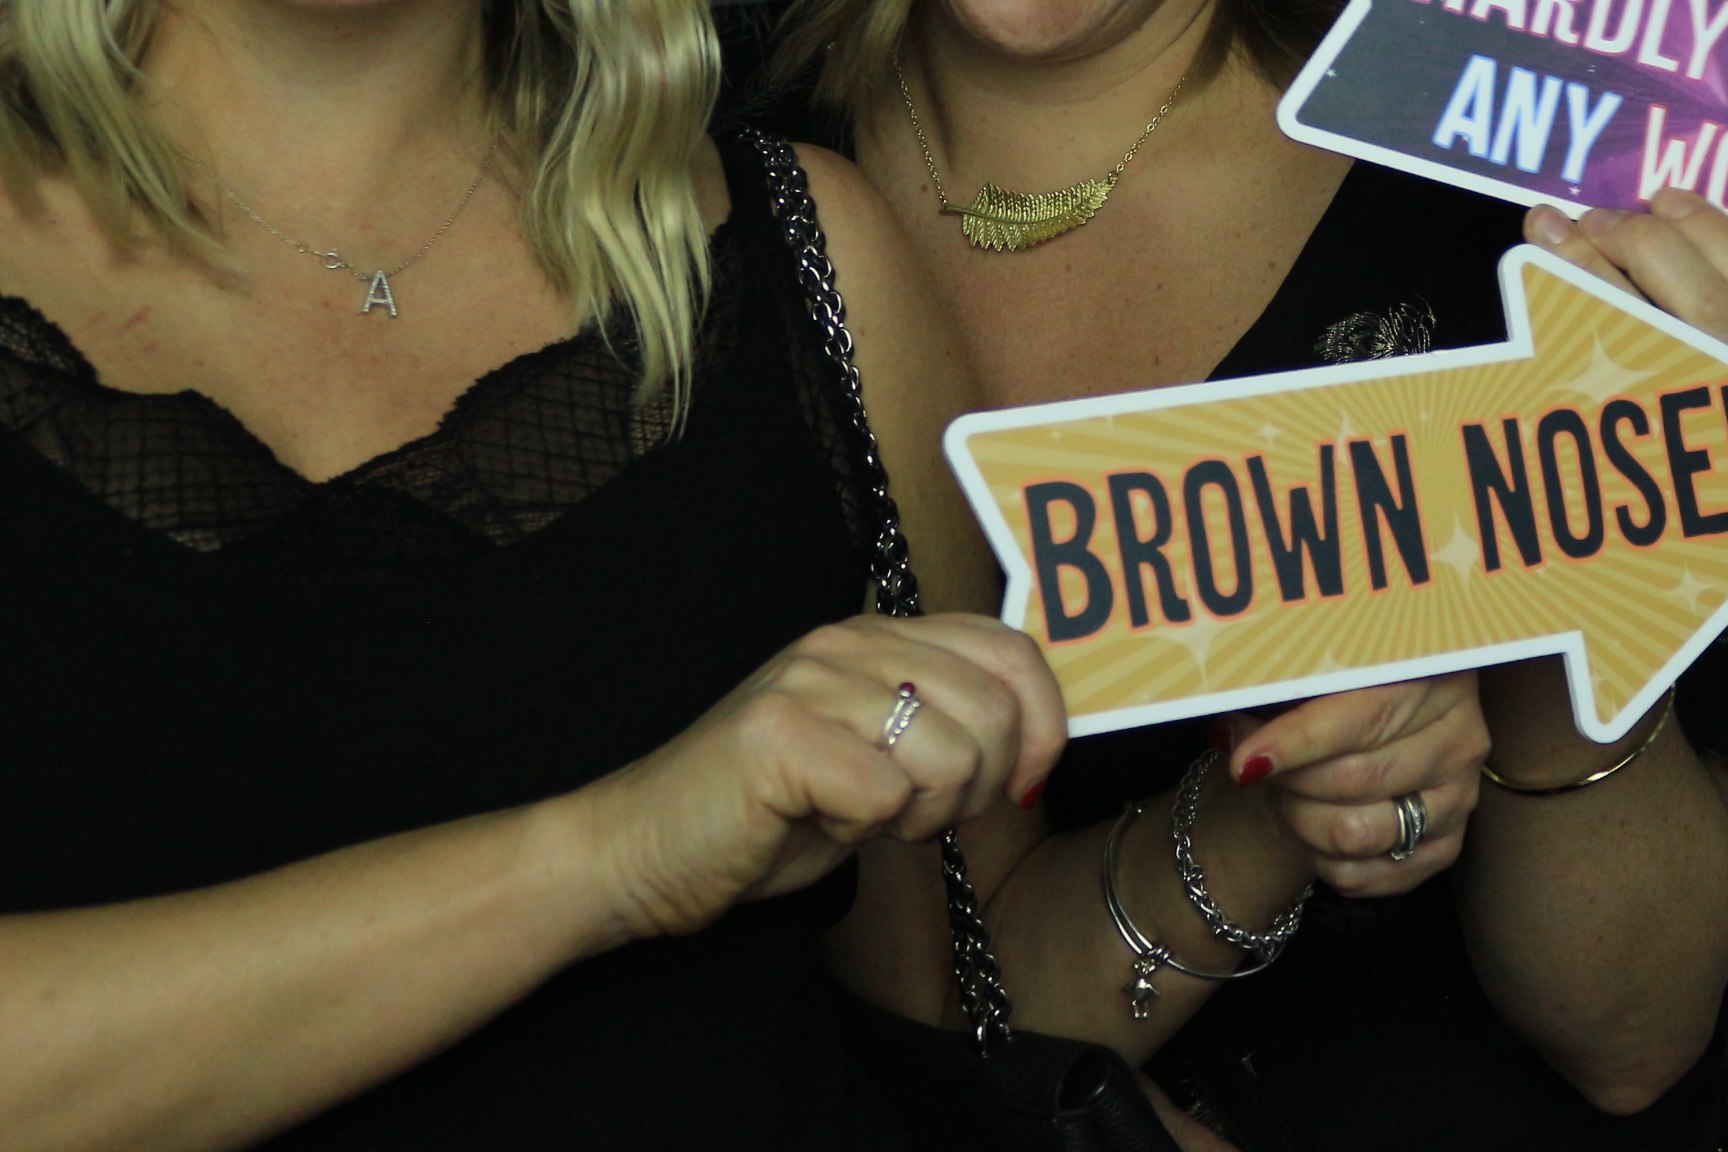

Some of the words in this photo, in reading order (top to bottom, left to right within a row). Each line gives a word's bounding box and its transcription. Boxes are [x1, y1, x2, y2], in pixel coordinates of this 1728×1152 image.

[1433, 55, 1622, 183] ANY
[363, 270, 398, 316] A
[1022, 432, 1433, 645] BROWN
